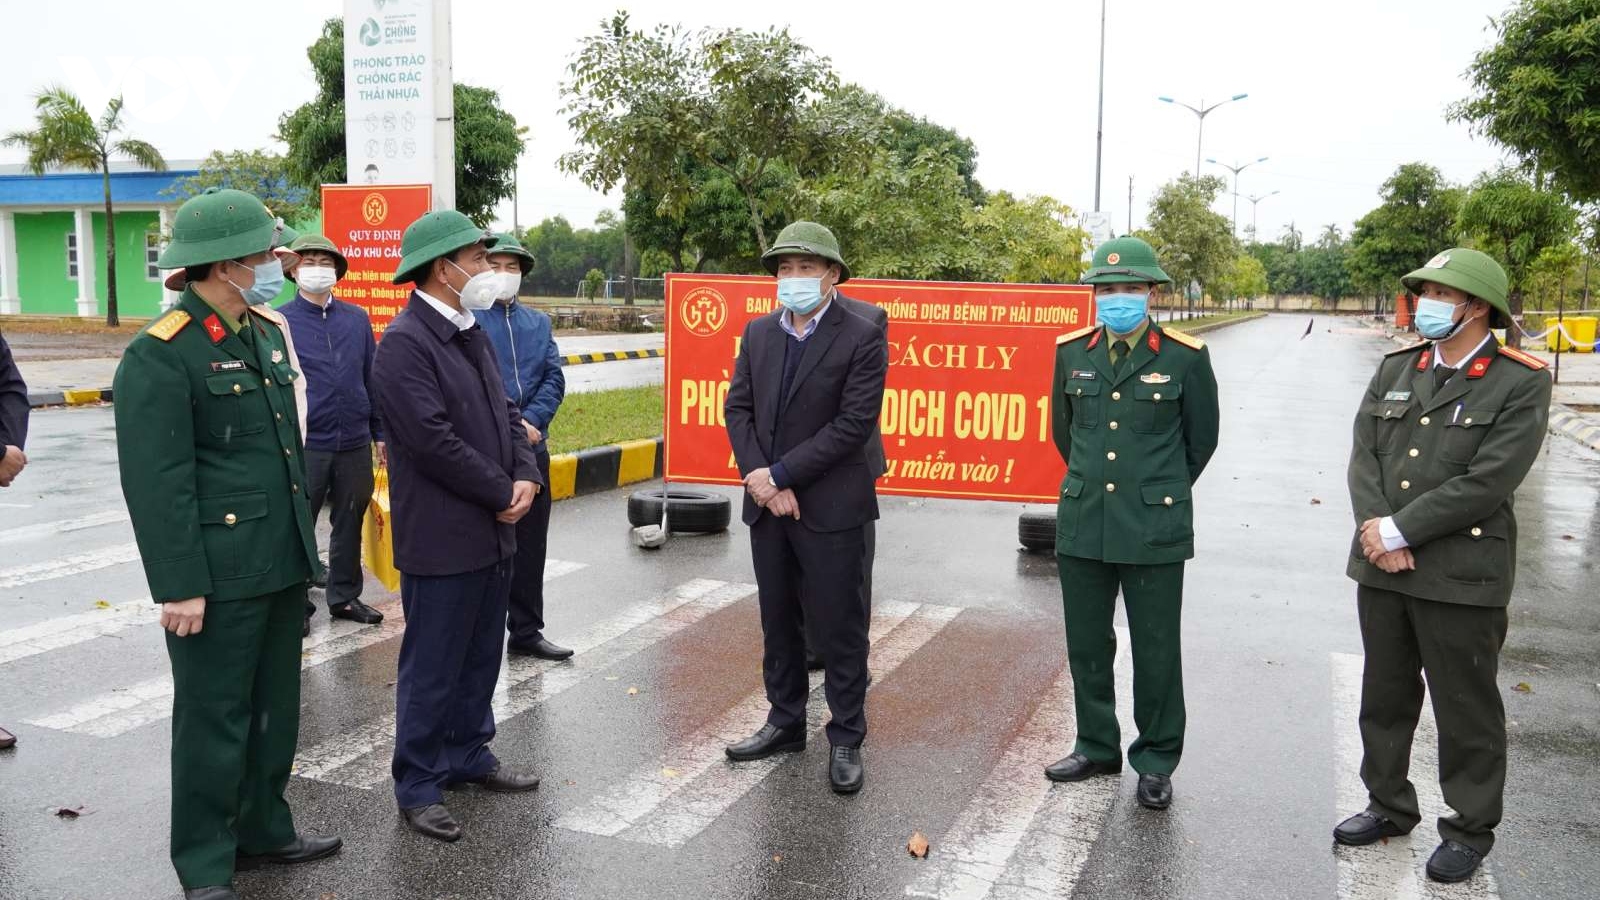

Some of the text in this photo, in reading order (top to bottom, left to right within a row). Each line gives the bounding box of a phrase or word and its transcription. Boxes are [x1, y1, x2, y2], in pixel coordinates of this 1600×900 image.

[353, 53, 426, 69] PHONG TRÀO
[356, 69, 422, 85] CHỐNG RÁC
[387, 87, 420, 102] NHỰA
[349, 229, 401, 243] QUY ĐỊNH
[342, 245, 361, 258] VÀO
[363, 247, 382, 258] KHU
[746, 297, 772, 314] BAN
[921, 302, 951, 324] DỊCH
[954, 302, 987, 325] BỆNH
[991, 306, 1006, 323] TP
[1009, 301, 1031, 323] HẢI
[1034, 305, 1079, 325] DƯƠNG
[887, 335, 1018, 370] CÁCH LY
[880, 388, 946, 447] DỊCH
[954, 391, 1026, 442] COVD
[901, 450, 956, 480] miễn
[961, 454, 1000, 482] vào
